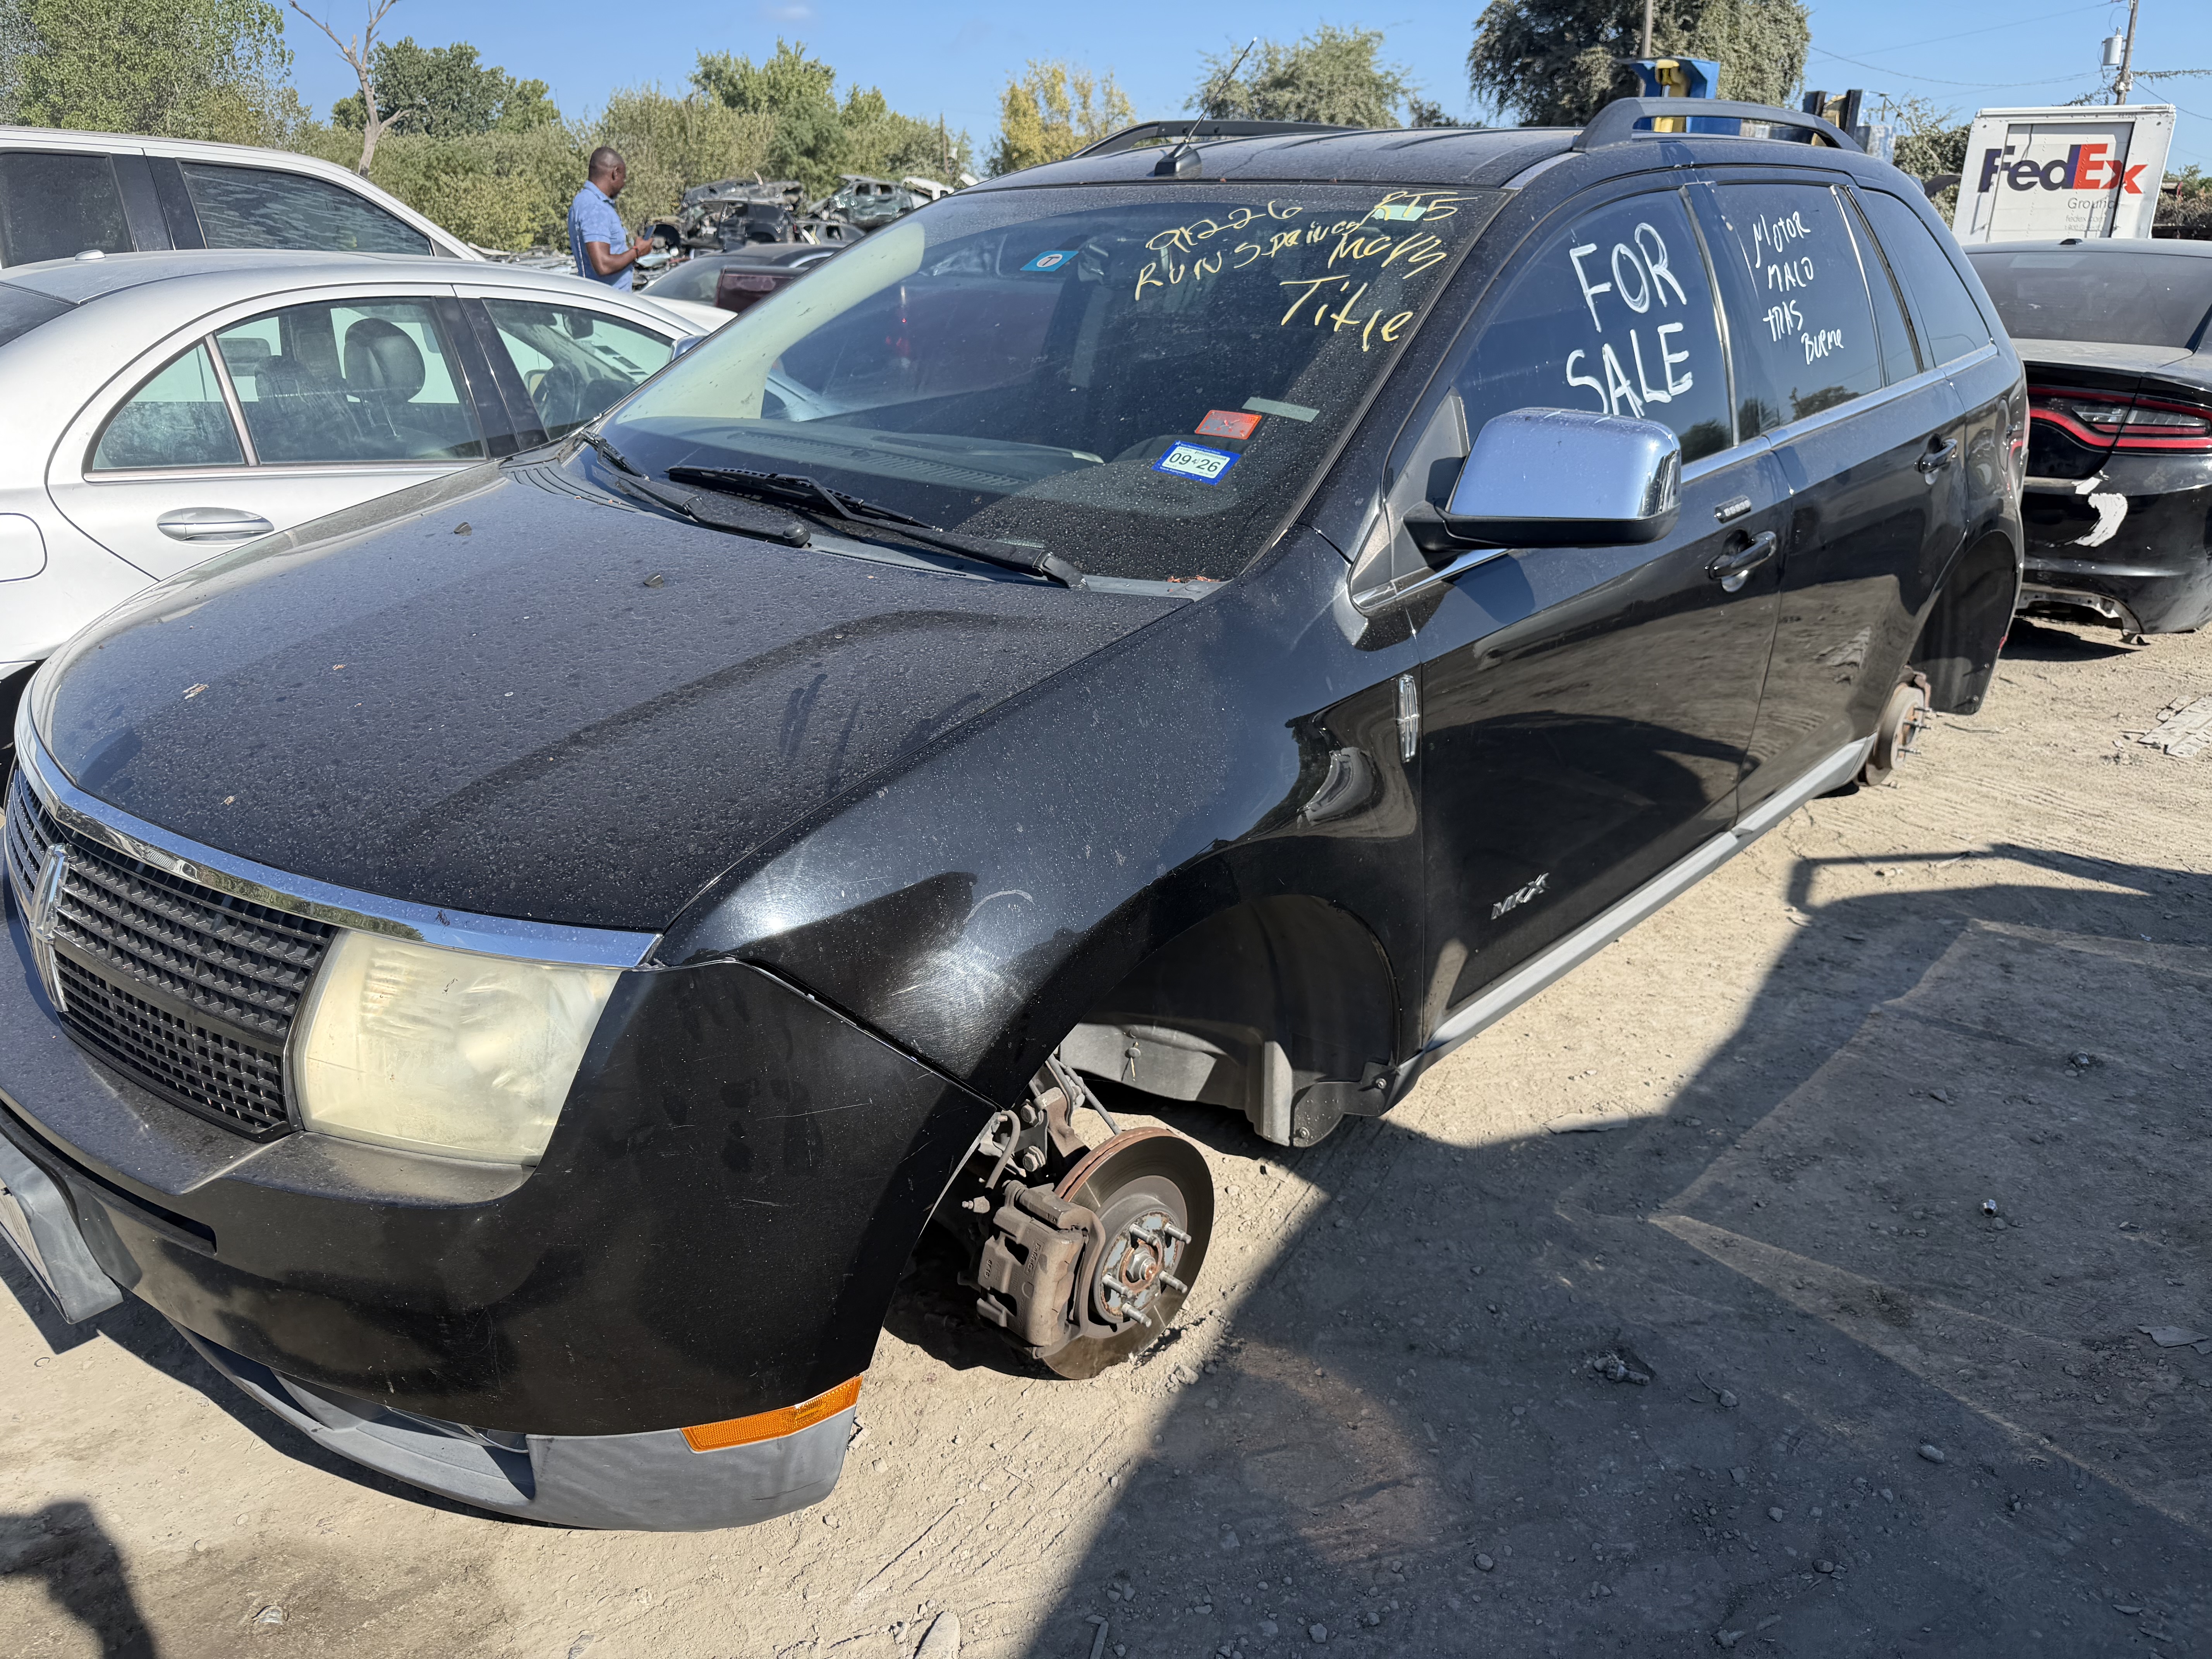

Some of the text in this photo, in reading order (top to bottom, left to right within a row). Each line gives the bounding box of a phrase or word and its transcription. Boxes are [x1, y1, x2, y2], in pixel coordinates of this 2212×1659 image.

[1977, 143, 2148, 194] FedEx
[1569, 222, 1687, 333] FOR
[1279, 275, 1413, 352] Title
[1566, 322, 1693, 419] SALE
[1169, 453, 1192, 465] 09
[1195, 459, 1221, 472] 26
[1491, 872, 1550, 920] MKX
